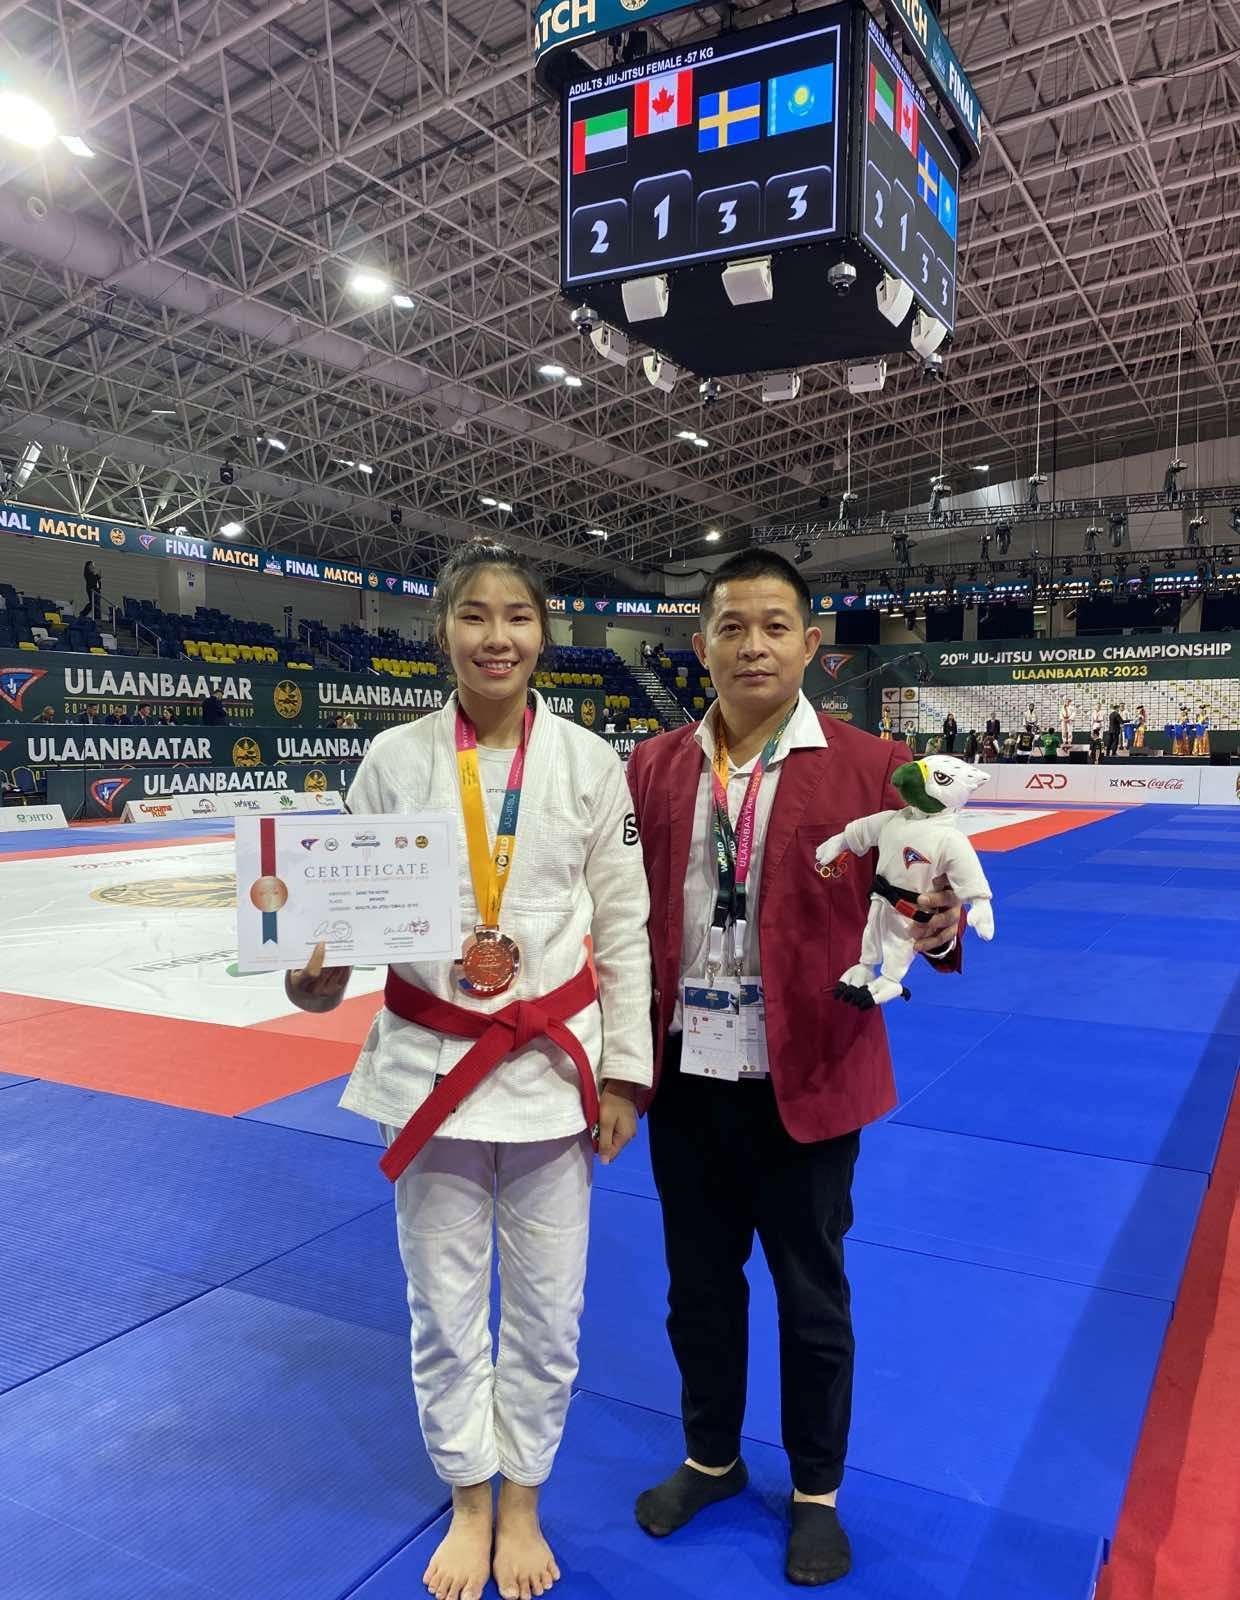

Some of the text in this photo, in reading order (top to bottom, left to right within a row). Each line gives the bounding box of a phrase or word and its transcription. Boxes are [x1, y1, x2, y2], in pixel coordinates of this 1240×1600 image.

[569, 47, 714, 97] ADULTS JIU-JITSU FEMALE -57 KG
[949, 61, 975, 131] FINAL
[590, 184, 809, 254] 2 1 3 3
[874, 188, 949, 307] 2 1 3 3
[0, 509, 100, 542] NAL MATCH
[165, 539, 259, 567] FINAL MATCH
[285, 559, 363, 585] FINAL MATCH
[402, 580, 430, 596] FINAL
[616, 602, 701, 614] FINAL MATCH
[940, 642, 1232, 666] 20TH JU-JITSU WORLD CHAMPIONSHIP
[64, 667, 254, 701] ULAANBAATAR
[1012, 665, 1148, 681] ULAANBAATAR-2023
[318, 682, 443, 708] ULAANBAATAR
[821, 702, 849, 710] WORLD
[27, 737, 212, 762] ULAANBAATAR
[277, 737, 372, 758] ULAANBAA
[143, 770, 288, 796] ULAANBAATAR
[1025, 773, 1068, 790] ARD
[1120, 779, 1147, 788] MCS
[717, 841, 729, 873] WORLD
[304, 863, 430, 878] CERTIFICATE
